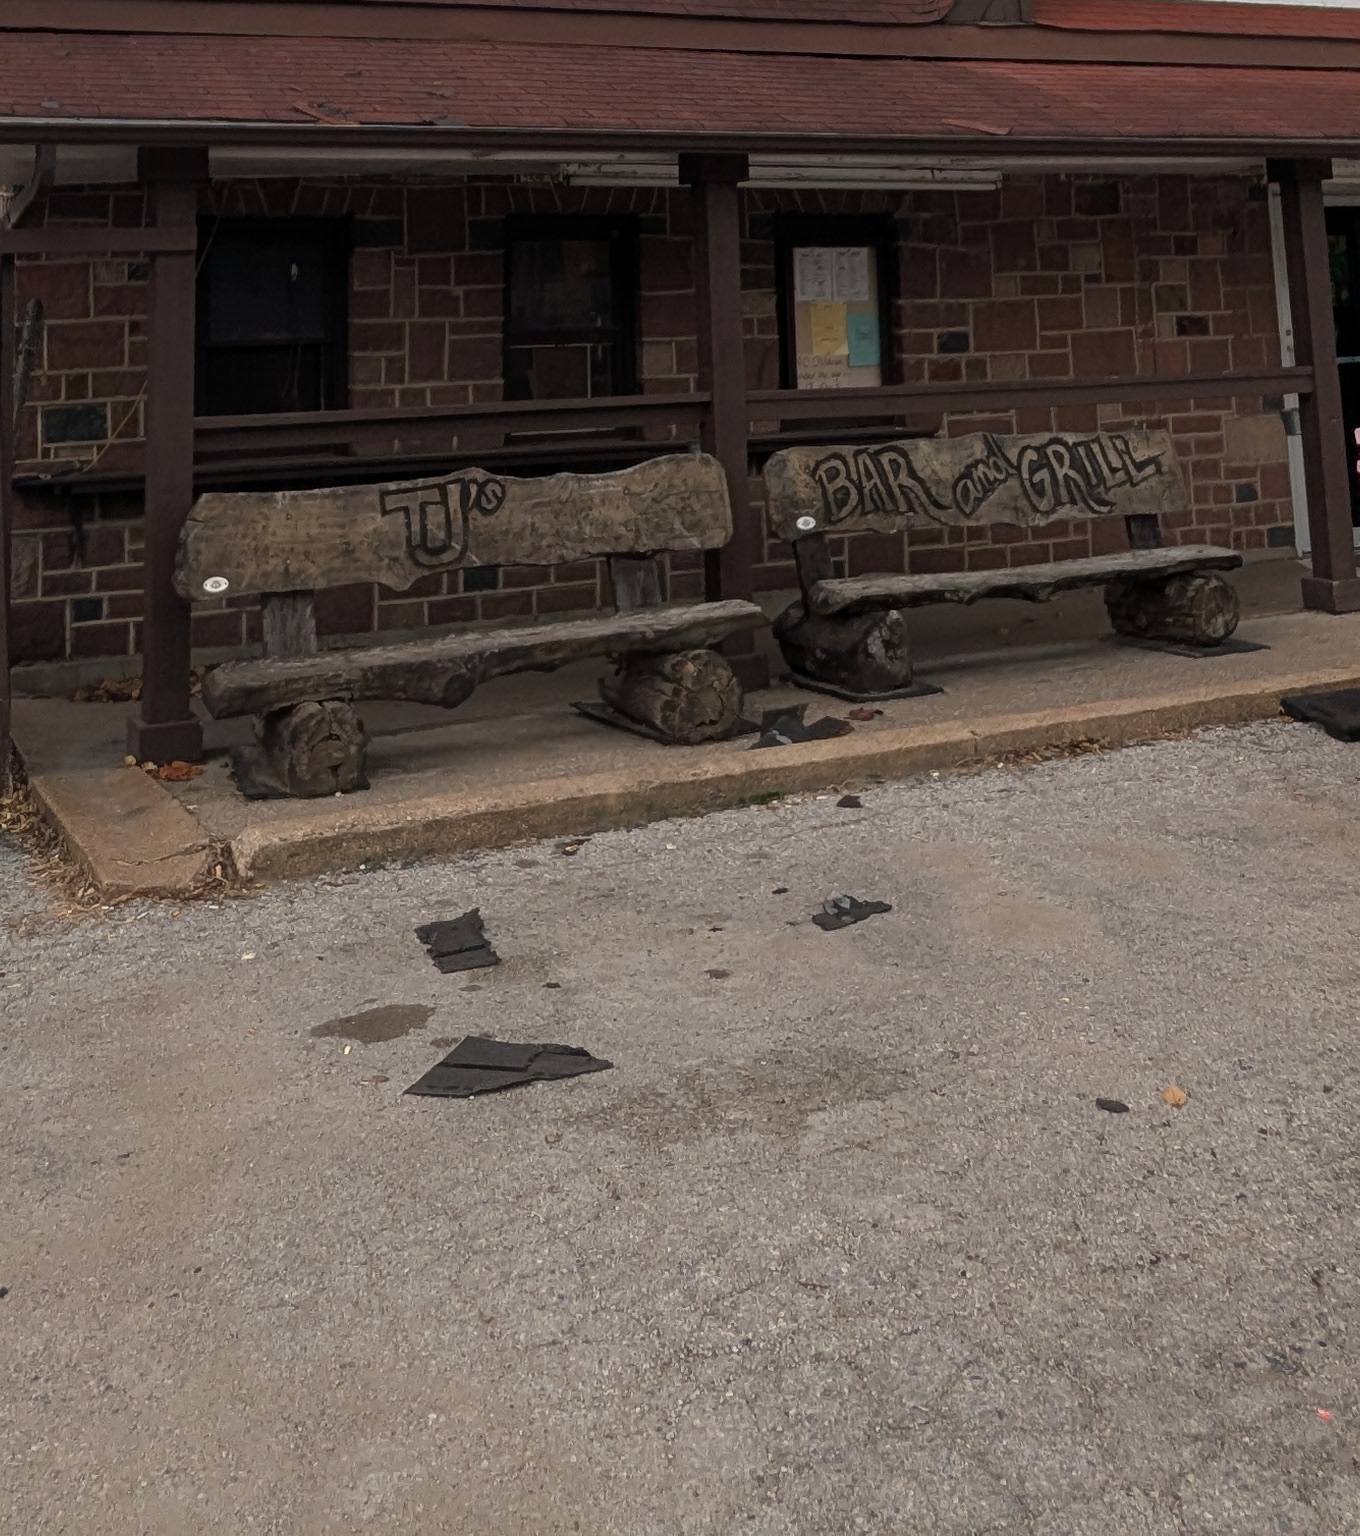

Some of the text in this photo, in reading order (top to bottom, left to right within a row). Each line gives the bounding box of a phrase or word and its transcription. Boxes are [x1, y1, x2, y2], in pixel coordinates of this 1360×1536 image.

[379, 476, 507, 568] TJ's
[812, 433, 1166, 526] BAR and GRILL
